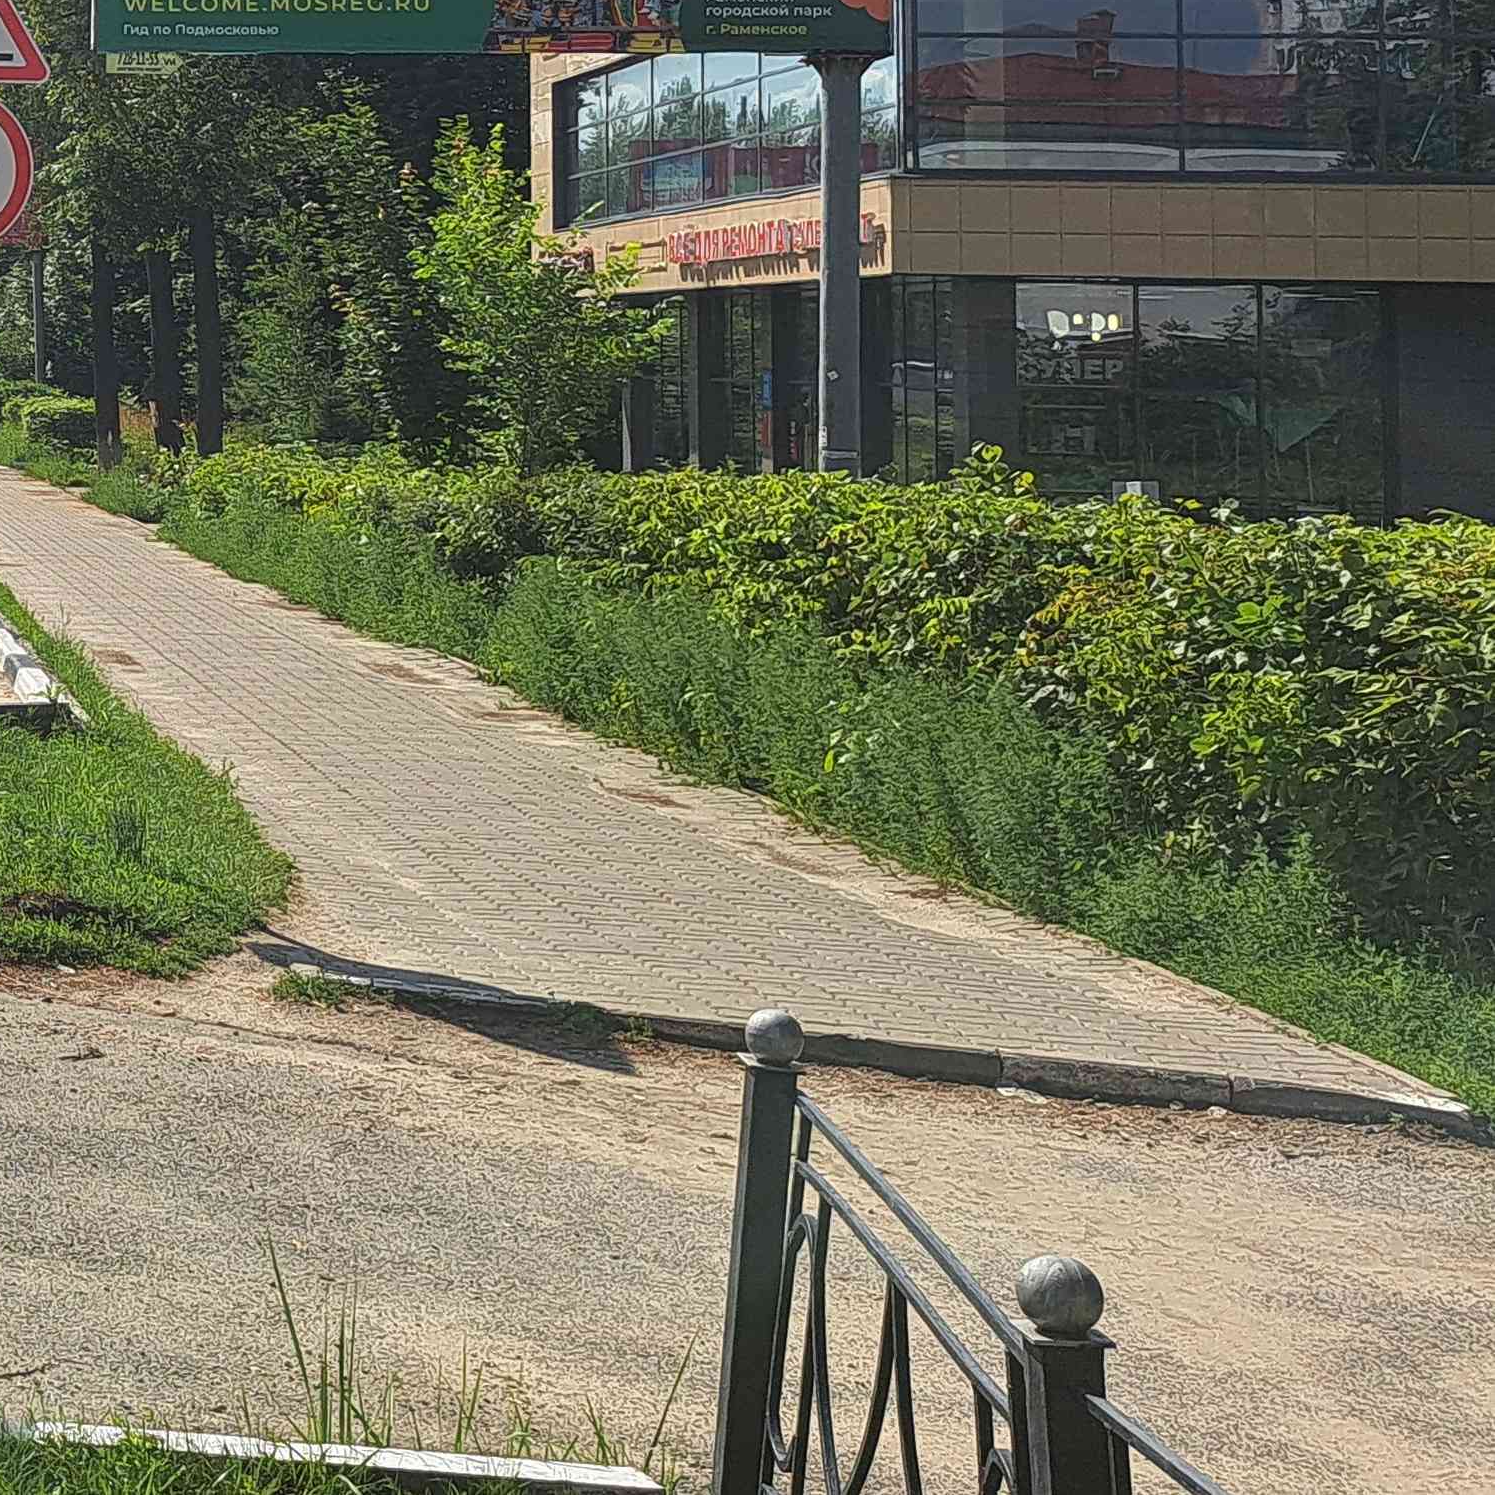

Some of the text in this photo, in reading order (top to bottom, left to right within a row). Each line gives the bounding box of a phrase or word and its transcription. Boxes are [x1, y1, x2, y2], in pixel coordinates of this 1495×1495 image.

[706, 4, 833, 18] городской парк
[123, 23, 280, 36] Гид по Подмосковью
[720, 23, 808, 35] Раменское
